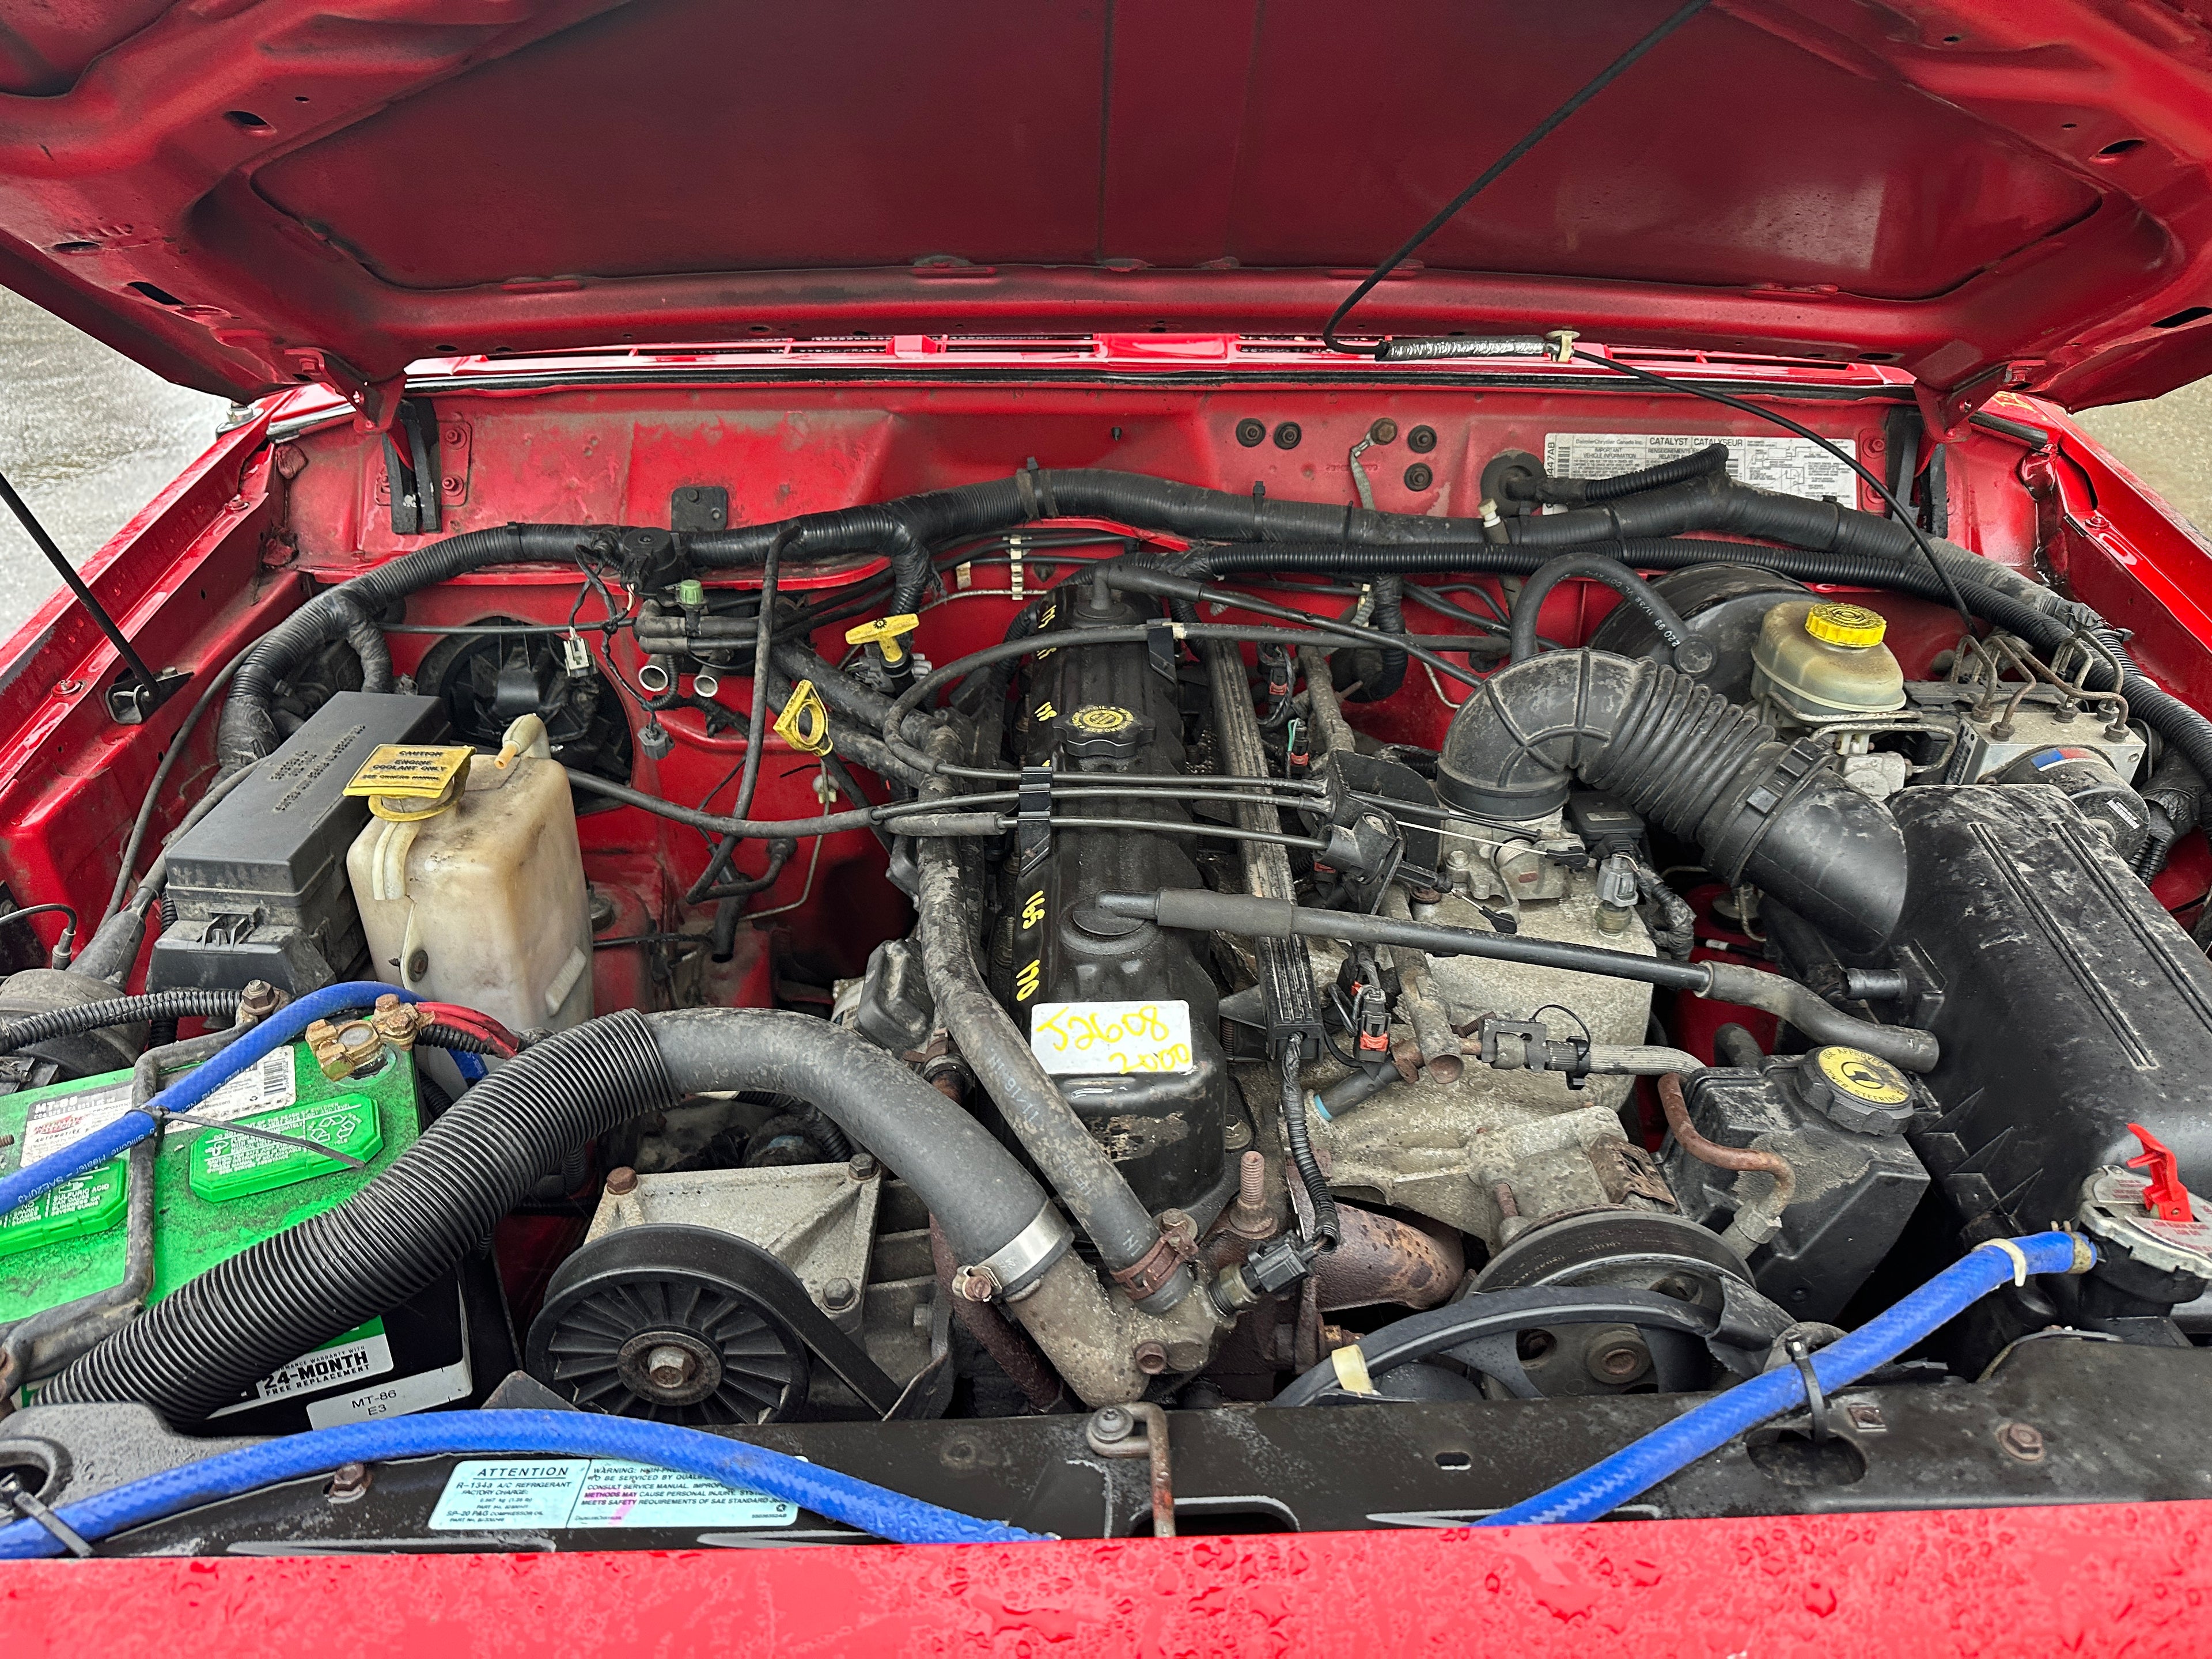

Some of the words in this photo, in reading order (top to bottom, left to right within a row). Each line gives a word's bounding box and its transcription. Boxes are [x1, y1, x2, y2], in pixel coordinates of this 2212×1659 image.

[1649, 437, 1688, 445] CATALYST
[1664, 630, 1680, 647] 220
[1022, 890, 1046, 929] 165
[1016, 959, 1040, 1001] 170
[1036, 1005, 1169, 1051] J2608
[1108, 1043, 1190, 1074] 2000
[1821, 1050, 1836, 1059] USE
[1837, 1048, 1885, 1066] APPROVED
[1823, 1068, 1849, 1088] POWER
[1854, 1090, 1901, 1103] STEERING
[52, 1187, 90, 1202] SULFURIC
[90, 1182, 110, 1193] ACID
[20, 1201, 35, 1210] NO
[310, 1350, 346, 1363] WARRANTY
[349, 1346, 365, 1354] WITH
[263, 1350, 368, 1389] 24-MONTH
[266, 1385, 291, 1396] FREE
[296, 1363, 370, 1388] REPLACEMENT
[351, 1389, 397, 1408] MT-86
[367, 1404, 387, 1416] E3
[477, 1467, 569, 1476] ATTENTION
